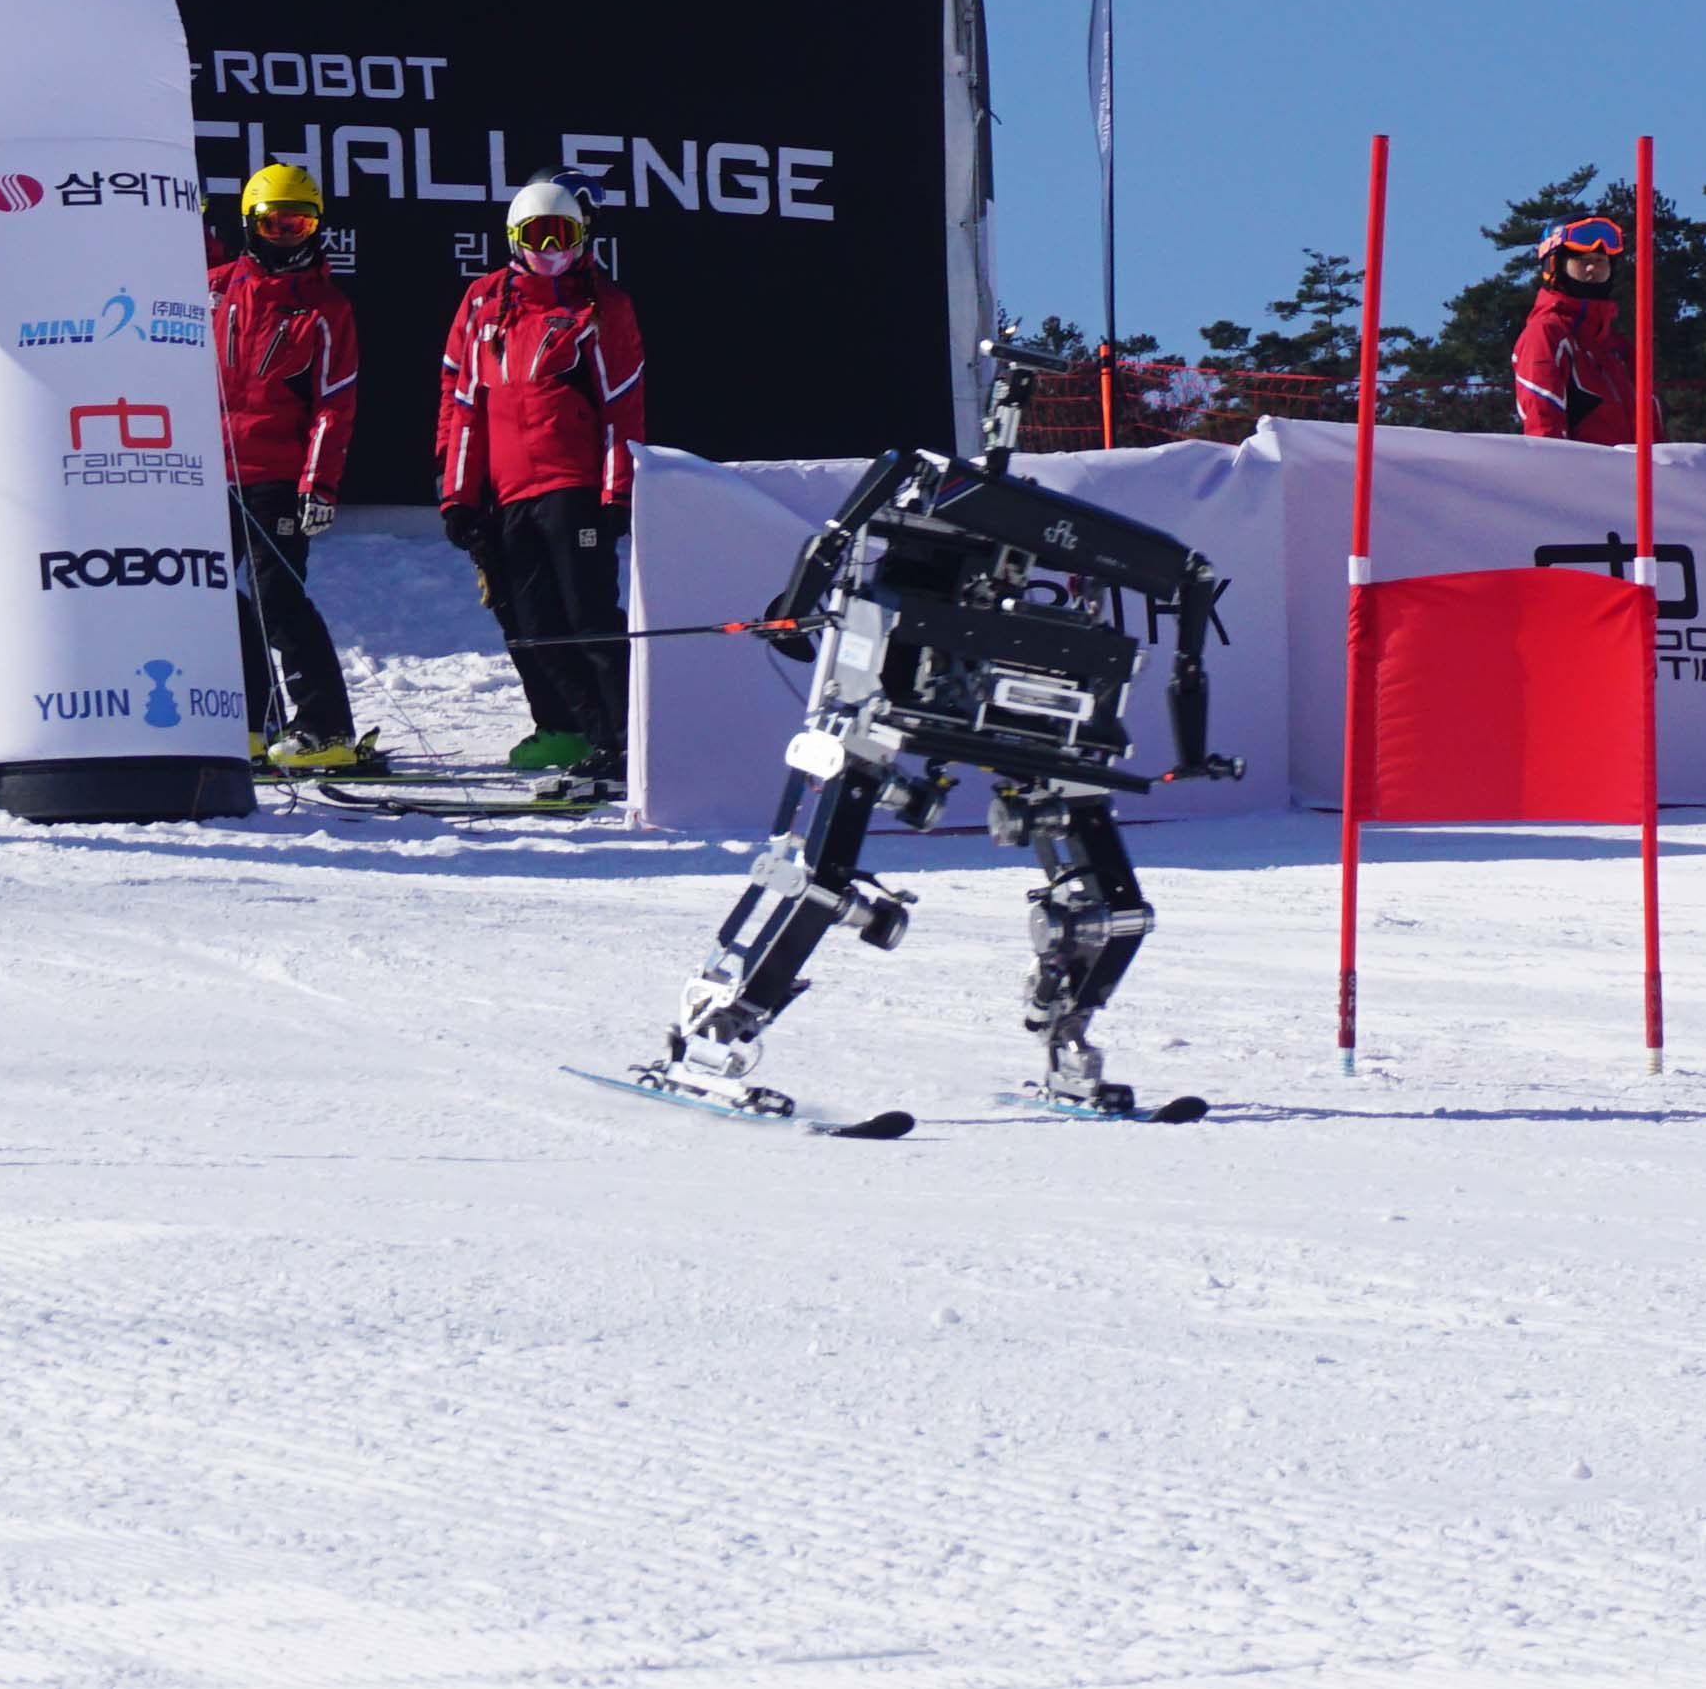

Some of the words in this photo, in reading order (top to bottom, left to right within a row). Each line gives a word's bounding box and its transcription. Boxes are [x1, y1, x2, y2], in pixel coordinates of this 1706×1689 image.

[214, 50, 448, 100] ROBOT
[54, 171, 200, 215] 삼익THK
[18, 319, 95, 347] MINI
[62, 453, 203, 469] rainbow
[39, 548, 228, 591] ROBOTIS
[34, 689, 131, 722] YUJIN
[189, 687, 244, 720] ROBOT
